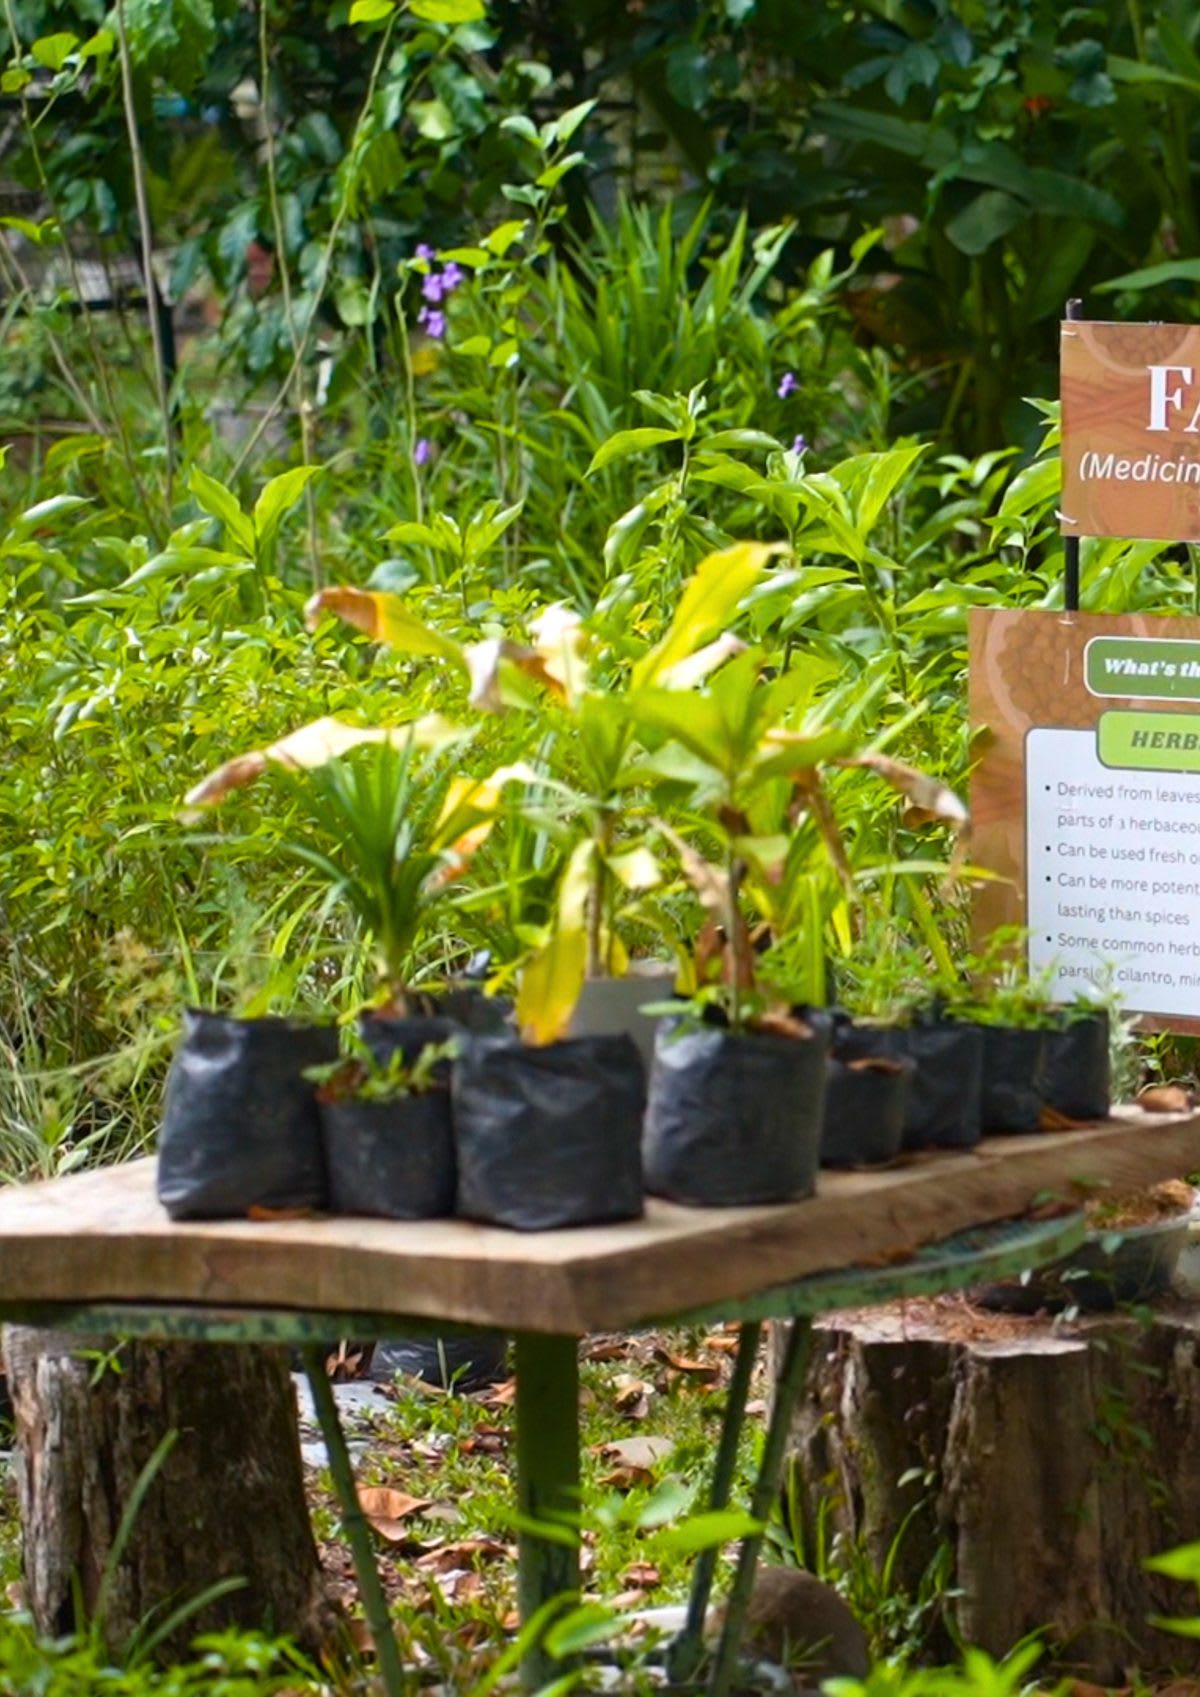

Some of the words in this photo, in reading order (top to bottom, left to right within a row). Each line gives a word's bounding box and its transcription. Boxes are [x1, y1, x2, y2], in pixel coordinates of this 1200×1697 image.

[1057, 782, 1113, 798] Derived
[1118, 784, 1152, 801] from
[1156, 788, 1200, 804] leaves
[1057, 814, 1095, 829] parts
[1099, 814, 1113, 829] of
[1057, 843, 1085, 856] Can
[1089, 844, 1107, 859] be
[1111, 845, 1145, 862] used
[1149, 847, 1186, 865] fresh
[1057, 873, 1085, 887] Can
[1089, 874, 1107, 889] be
[1111, 881, 1149, 892] more
[1152, 882, 1200, 897] potent
[1057, 903, 1106, 923] lasting
[1109, 907, 1142, 922] than
[1145, 912, 1190, 926] spices
[1057, 933, 1099, 949] Some
[1102, 939, 1165, 954] common
[1058, 964, 1114, 982] parsle,
[1117, 968, 1176, 987] cilantro,
